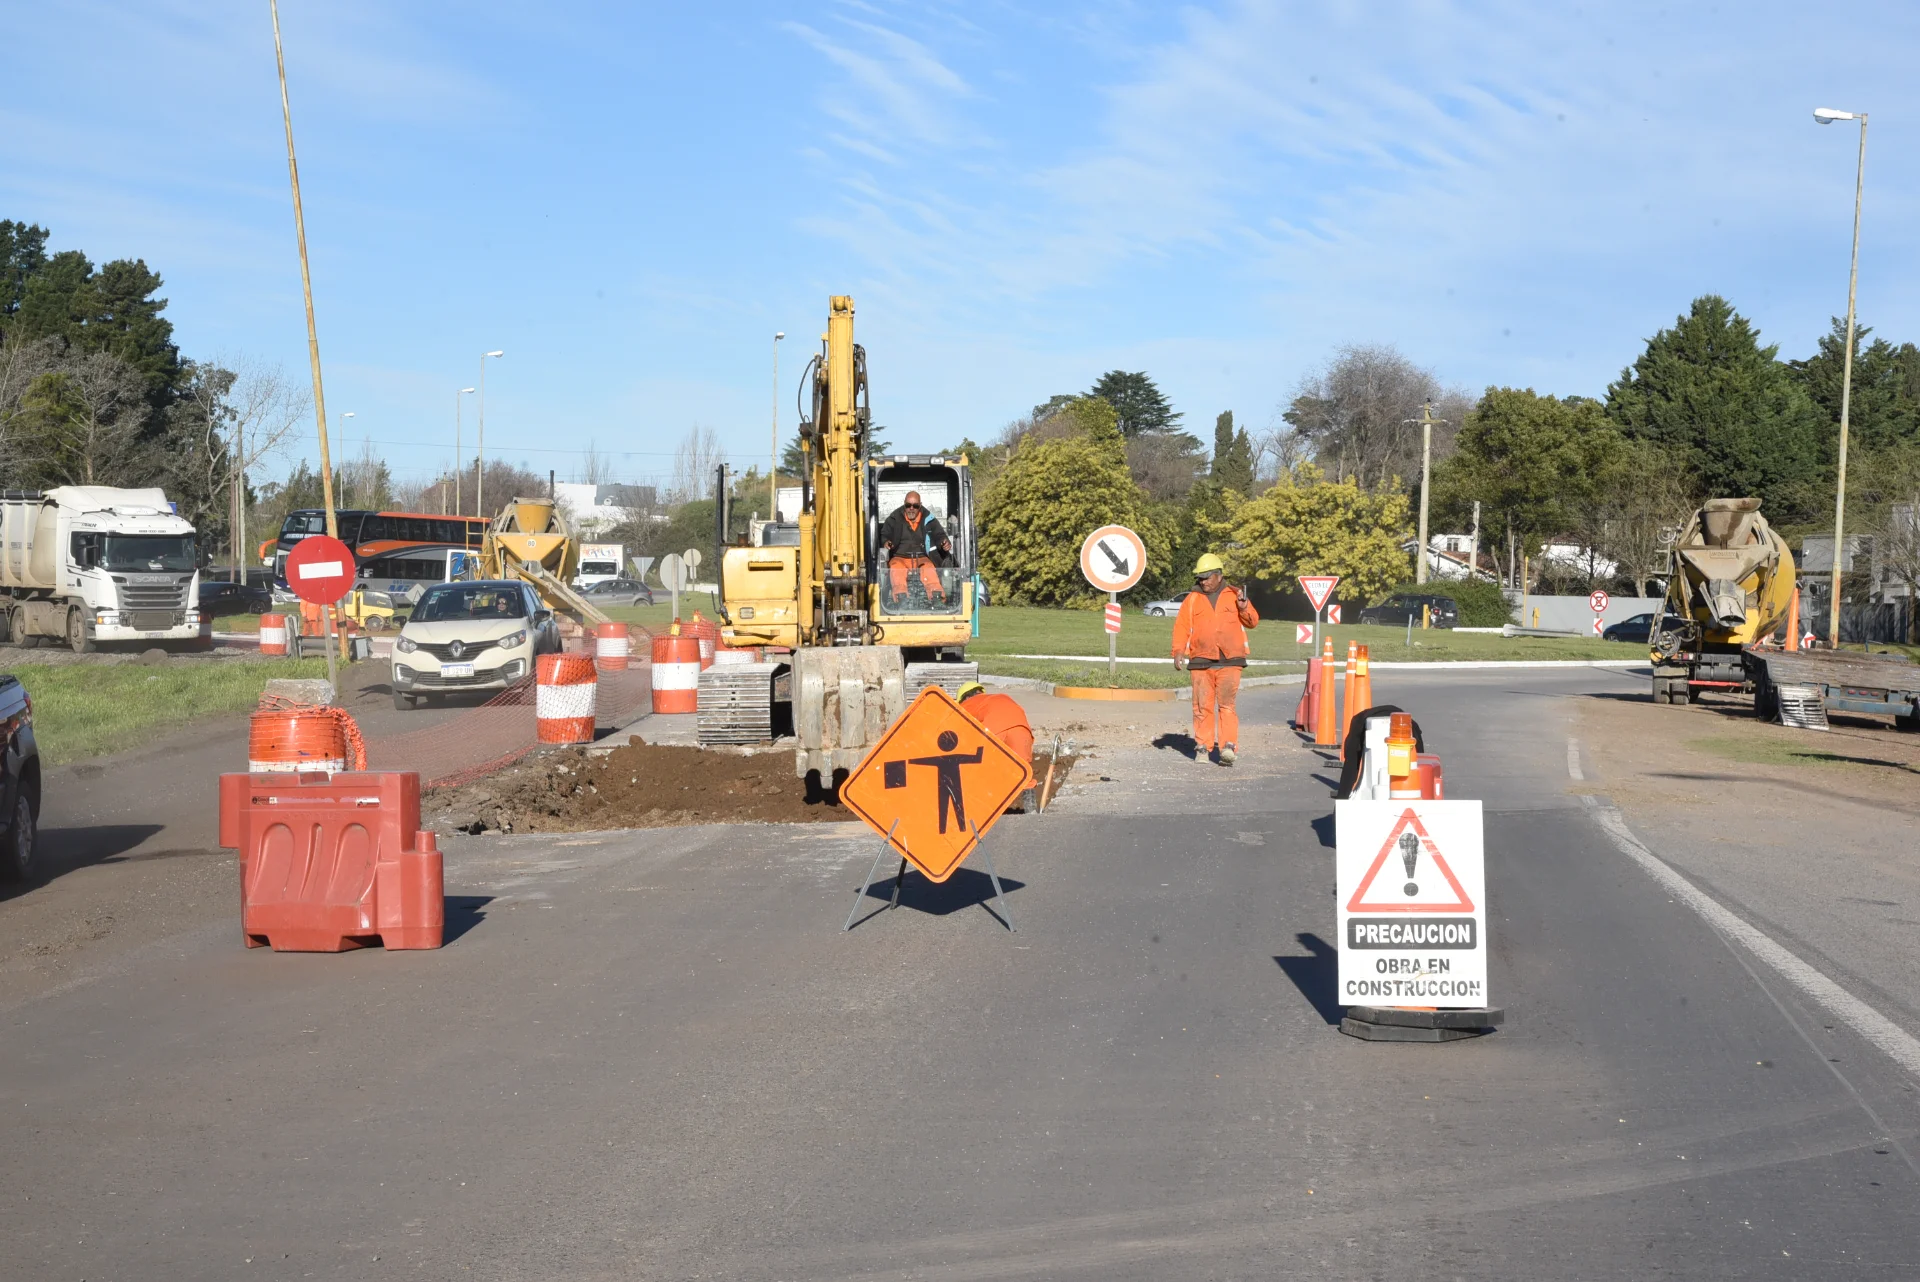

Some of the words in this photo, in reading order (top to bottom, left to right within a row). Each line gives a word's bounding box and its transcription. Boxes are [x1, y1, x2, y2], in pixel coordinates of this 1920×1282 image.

[1355, 924, 1471, 944] PRECAUCION
[1376, 958, 1422, 974] OBRA
[1428, 958, 1450, 974] EN
[1346, 980, 1481, 997] CONSTRUCCION
